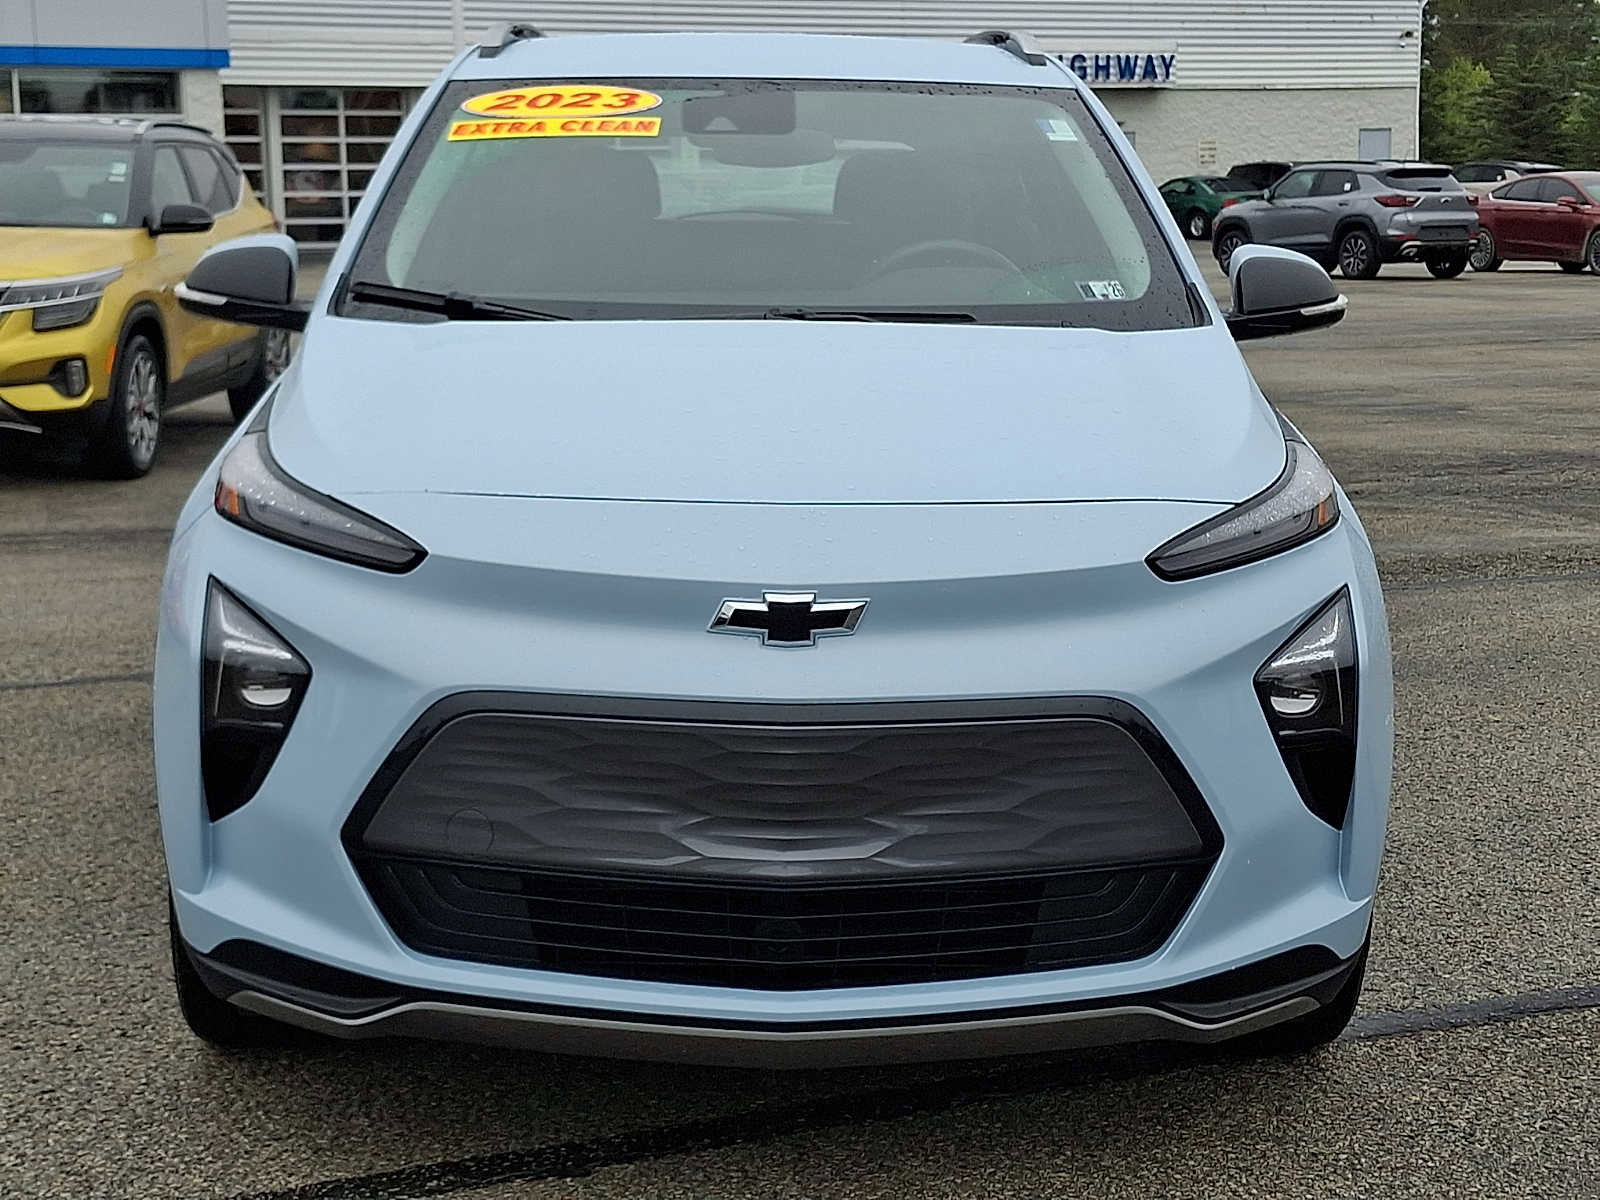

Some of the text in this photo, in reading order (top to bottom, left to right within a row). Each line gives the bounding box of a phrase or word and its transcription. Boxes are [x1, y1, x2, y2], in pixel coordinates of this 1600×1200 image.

[1058, 54, 1175, 80] GHWAY
[483, 93, 641, 111] 2023
[452, 120, 654, 136] EXTRA CLEAN
